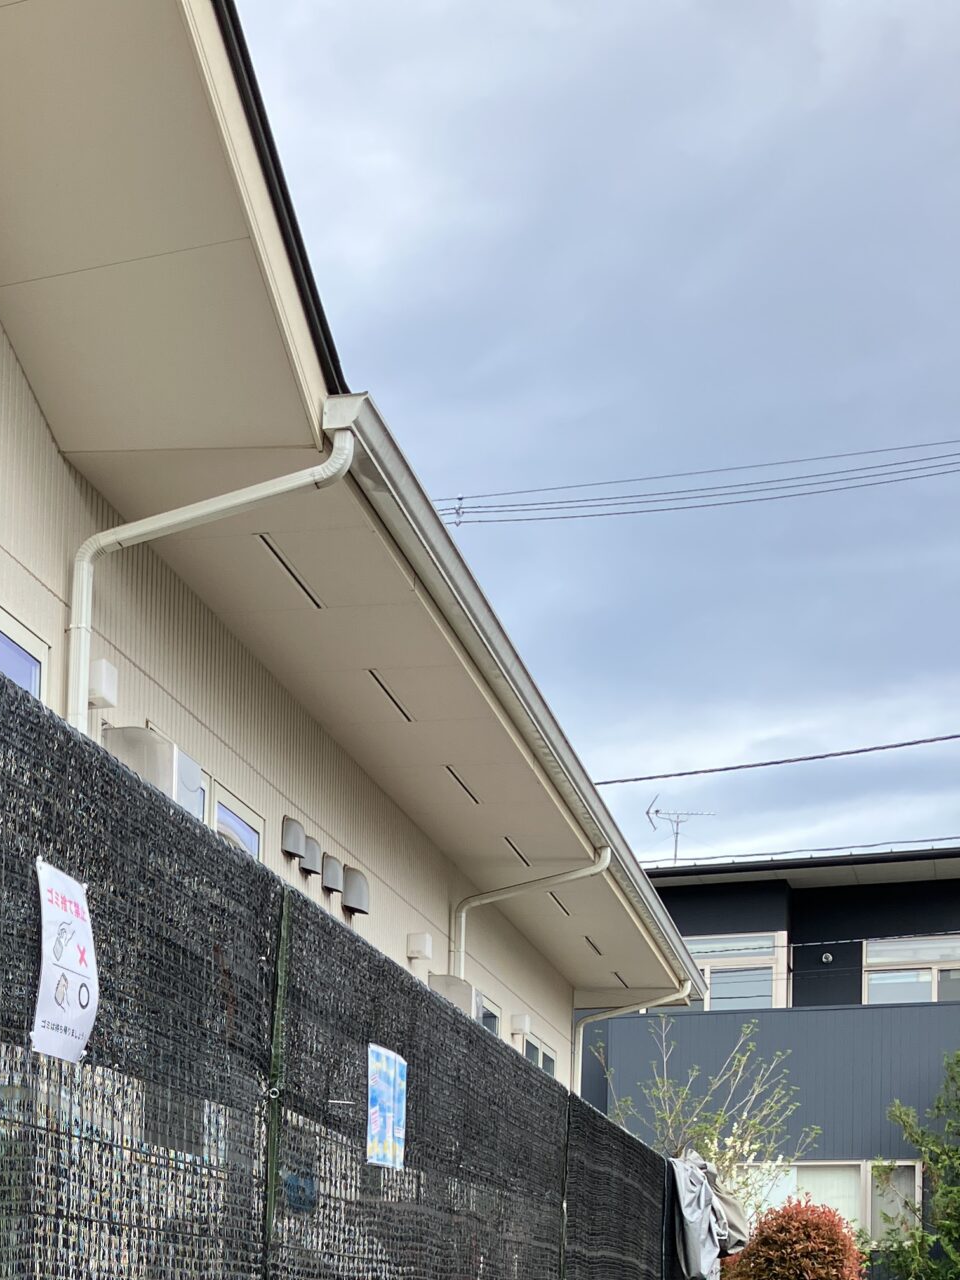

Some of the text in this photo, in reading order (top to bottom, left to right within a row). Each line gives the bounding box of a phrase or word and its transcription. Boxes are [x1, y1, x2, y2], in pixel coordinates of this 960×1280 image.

[47, 888, 86, 921] ゴミ捨て禁止
